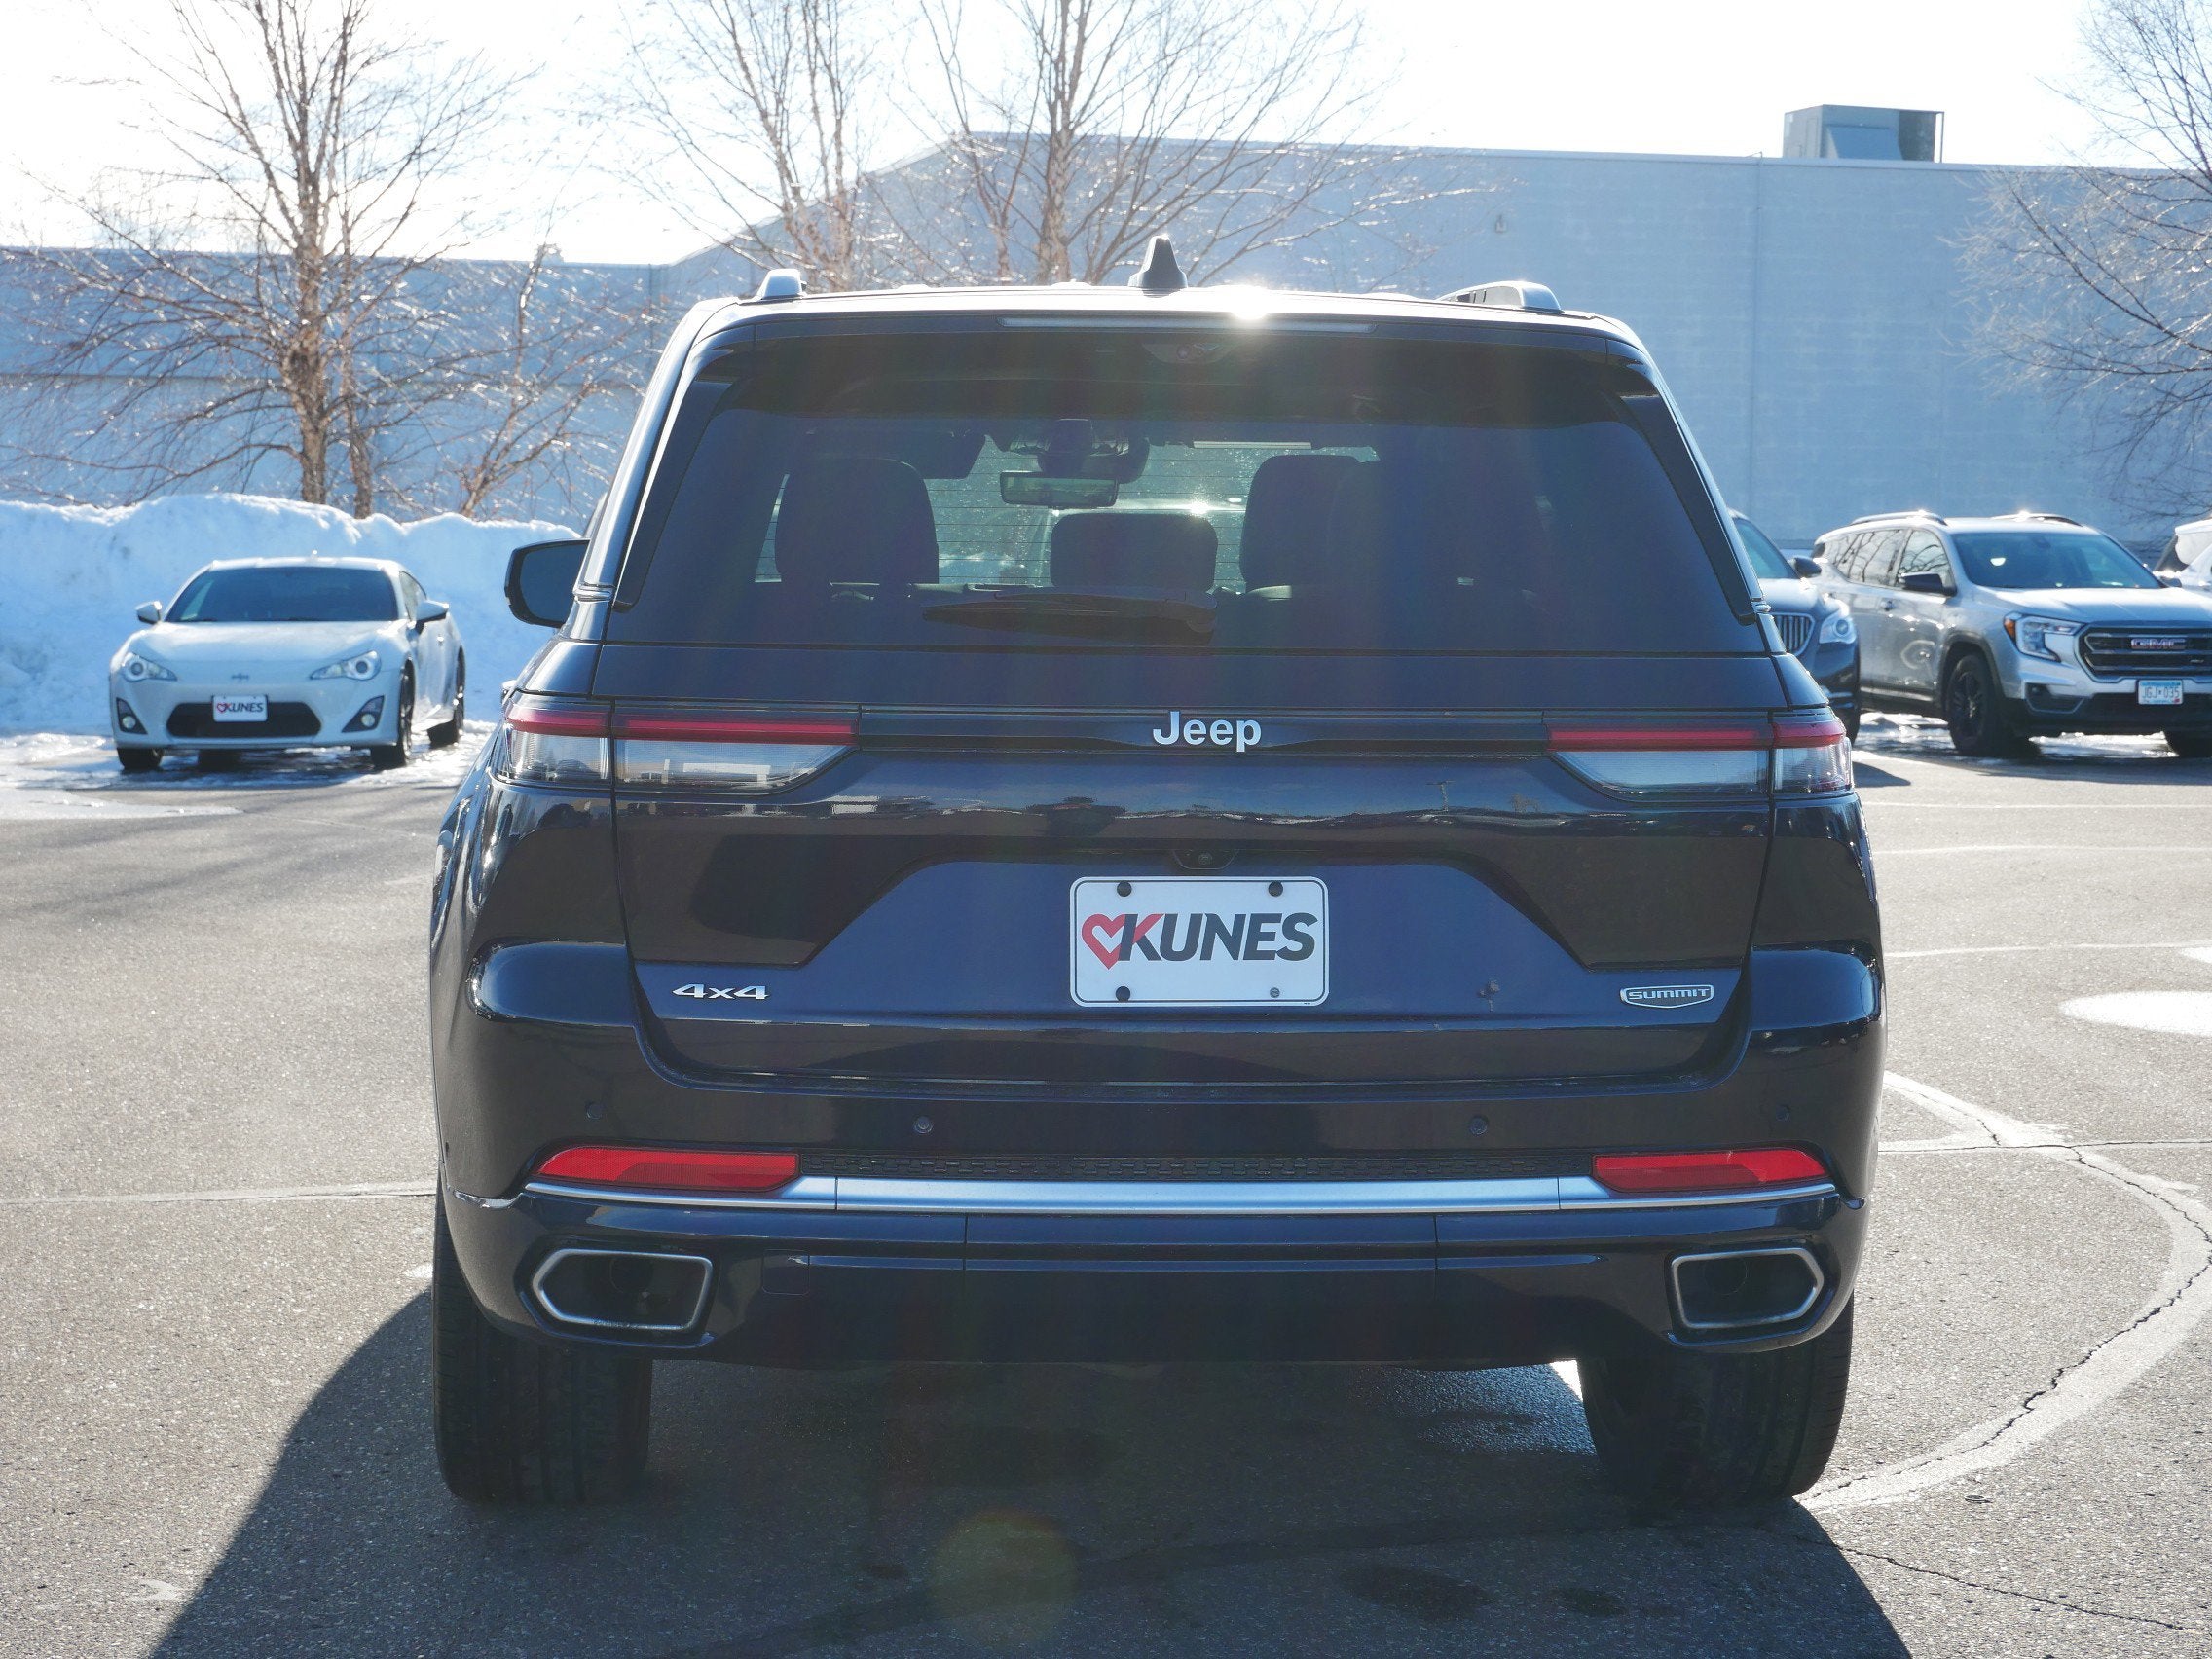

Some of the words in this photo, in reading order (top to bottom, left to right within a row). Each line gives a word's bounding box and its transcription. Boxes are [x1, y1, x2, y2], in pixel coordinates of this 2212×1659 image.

[226, 702, 264, 712] KUNES
[1153, 711, 1262, 752] Jeep
[1119, 912, 1318, 961] KUNES
[672, 984, 769, 1000] 4x4
[1628, 988, 1710, 1000] SUMMIT
